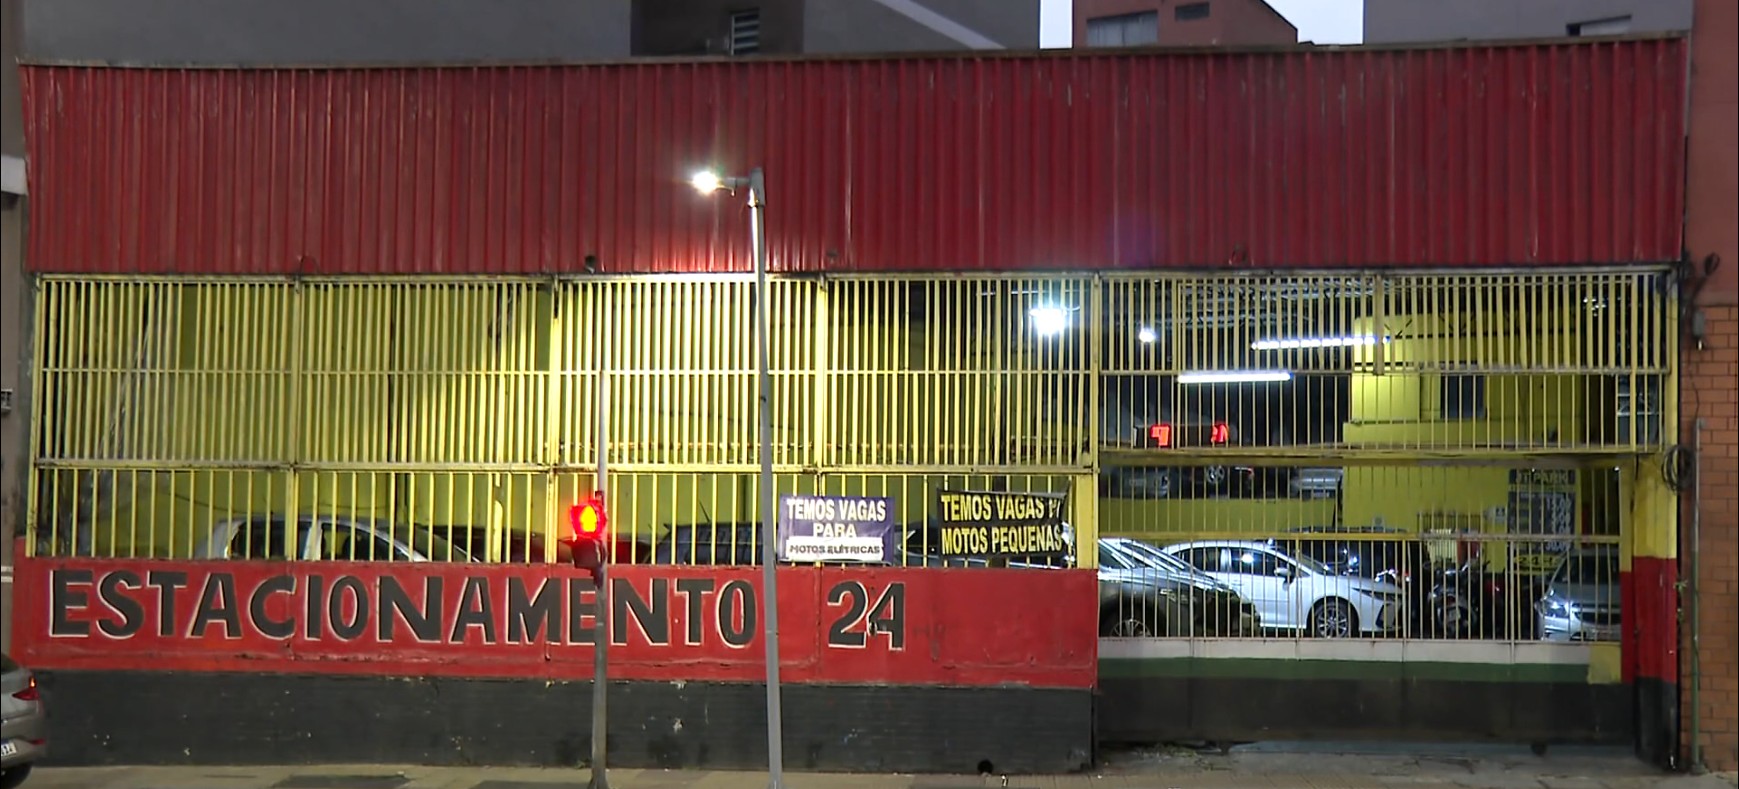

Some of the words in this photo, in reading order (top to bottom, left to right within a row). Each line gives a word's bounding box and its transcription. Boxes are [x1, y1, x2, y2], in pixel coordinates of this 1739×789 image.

[786, 498, 835, 520] TEMOS
[839, 499, 886, 521] VAGAS
[941, 494, 991, 521] TEMOS
[996, 495, 1044, 519] VAGAS
[813, 522, 857, 537] PARA
[942, 525, 988, 554] MOTOS
[992, 524, 1061, 553] PEQUENAS
[789, 544, 825, 554] MOTOS
[48, 569, 757, 648] ESTACIONAMENTO
[826, 580, 907, 651] 24
